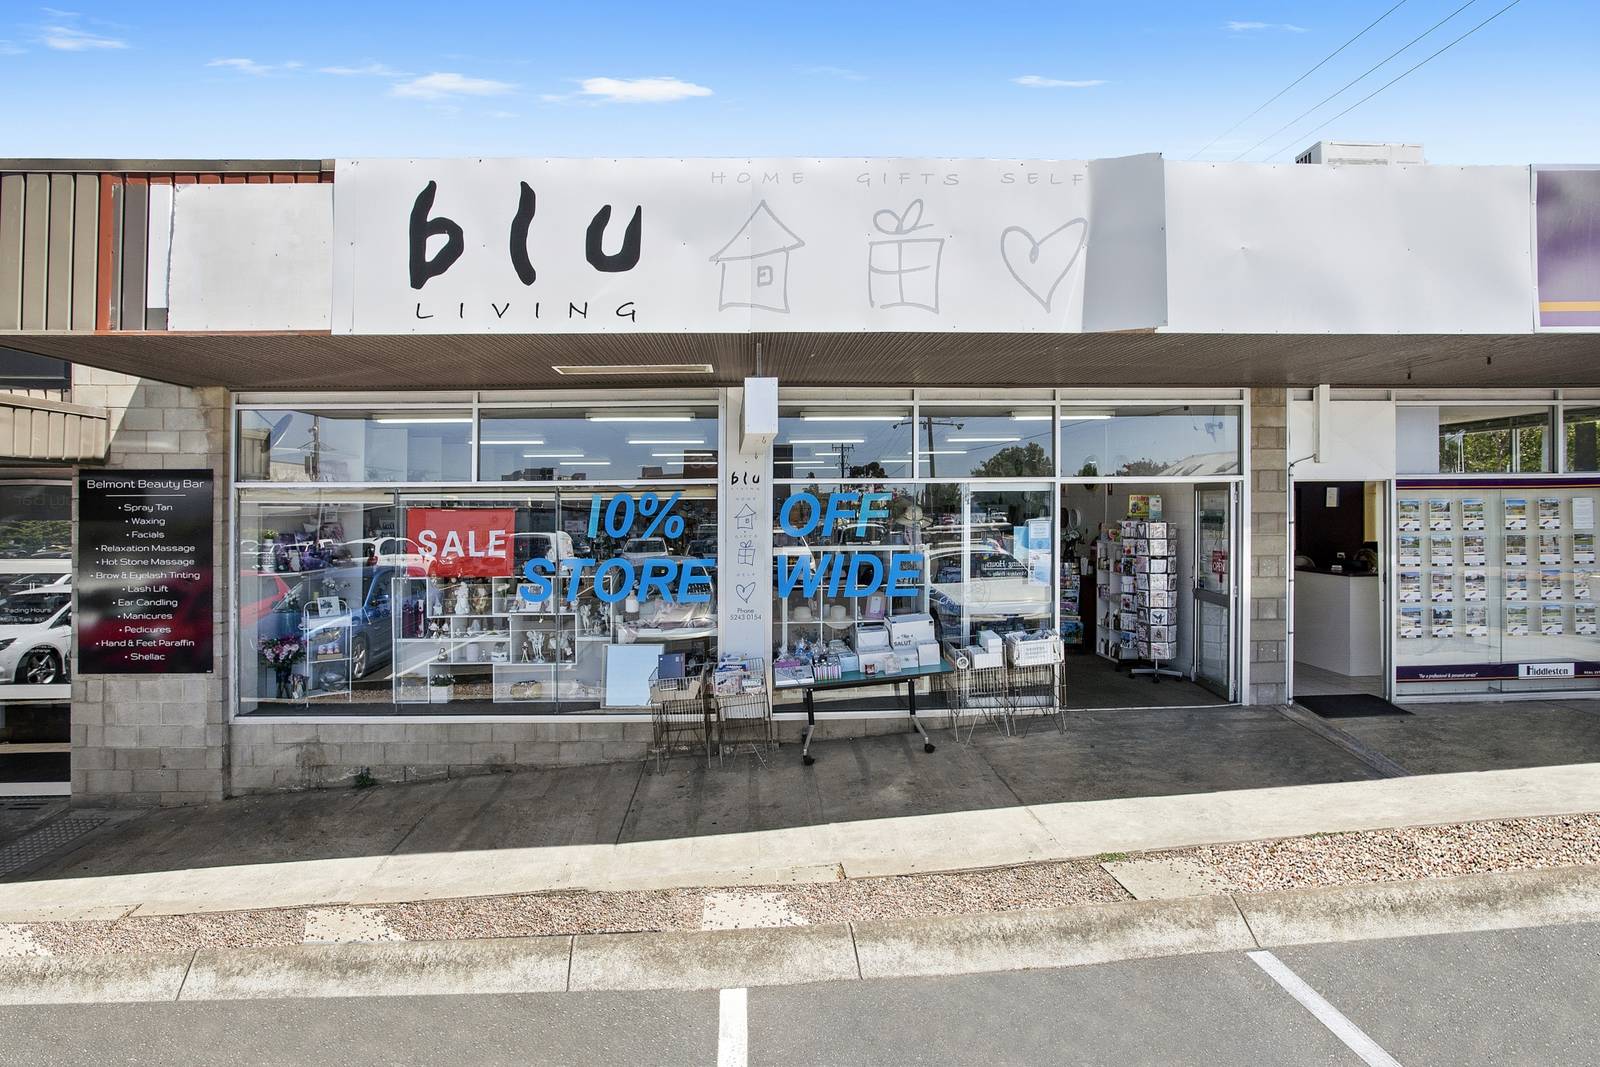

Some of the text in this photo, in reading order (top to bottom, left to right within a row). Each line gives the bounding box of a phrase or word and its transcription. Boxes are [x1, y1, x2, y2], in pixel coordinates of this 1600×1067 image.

[711, 171, 1083, 187] HOME GIFTS SELF
[409, 181, 641, 289] blu
[416, 302, 636, 322] LIVING
[731, 471, 760, 485] blu
[86, 479, 205, 490] Belmont Beauty Bar
[123, 503, 173, 513] Spray Tan
[588, 492, 893, 539] 10% OFF
[131, 517, 166, 526] Waxing
[131, 531, 165, 539] Facials
[100, 544, 196, 553] Relaxation Massage
[418, 529, 506, 559] SALE
[101, 558, 195, 567] Hot Stone Massage
[95, 571, 201, 580] Brow & Eyelash Tinting
[519, 553, 924, 603] STORE WIDE
[127, 584, 169, 593] Lash Lift
[118, 598, 178, 608] Ear Candling
[123, 612, 173, 620] Manicures
[729, 613, 762, 621] 5243 0154
[124, 625, 172, 634] Pedicures
[101, 638, 195, 647] Hand & Feet Paraffin
[130, 652, 166, 661] Shellac
